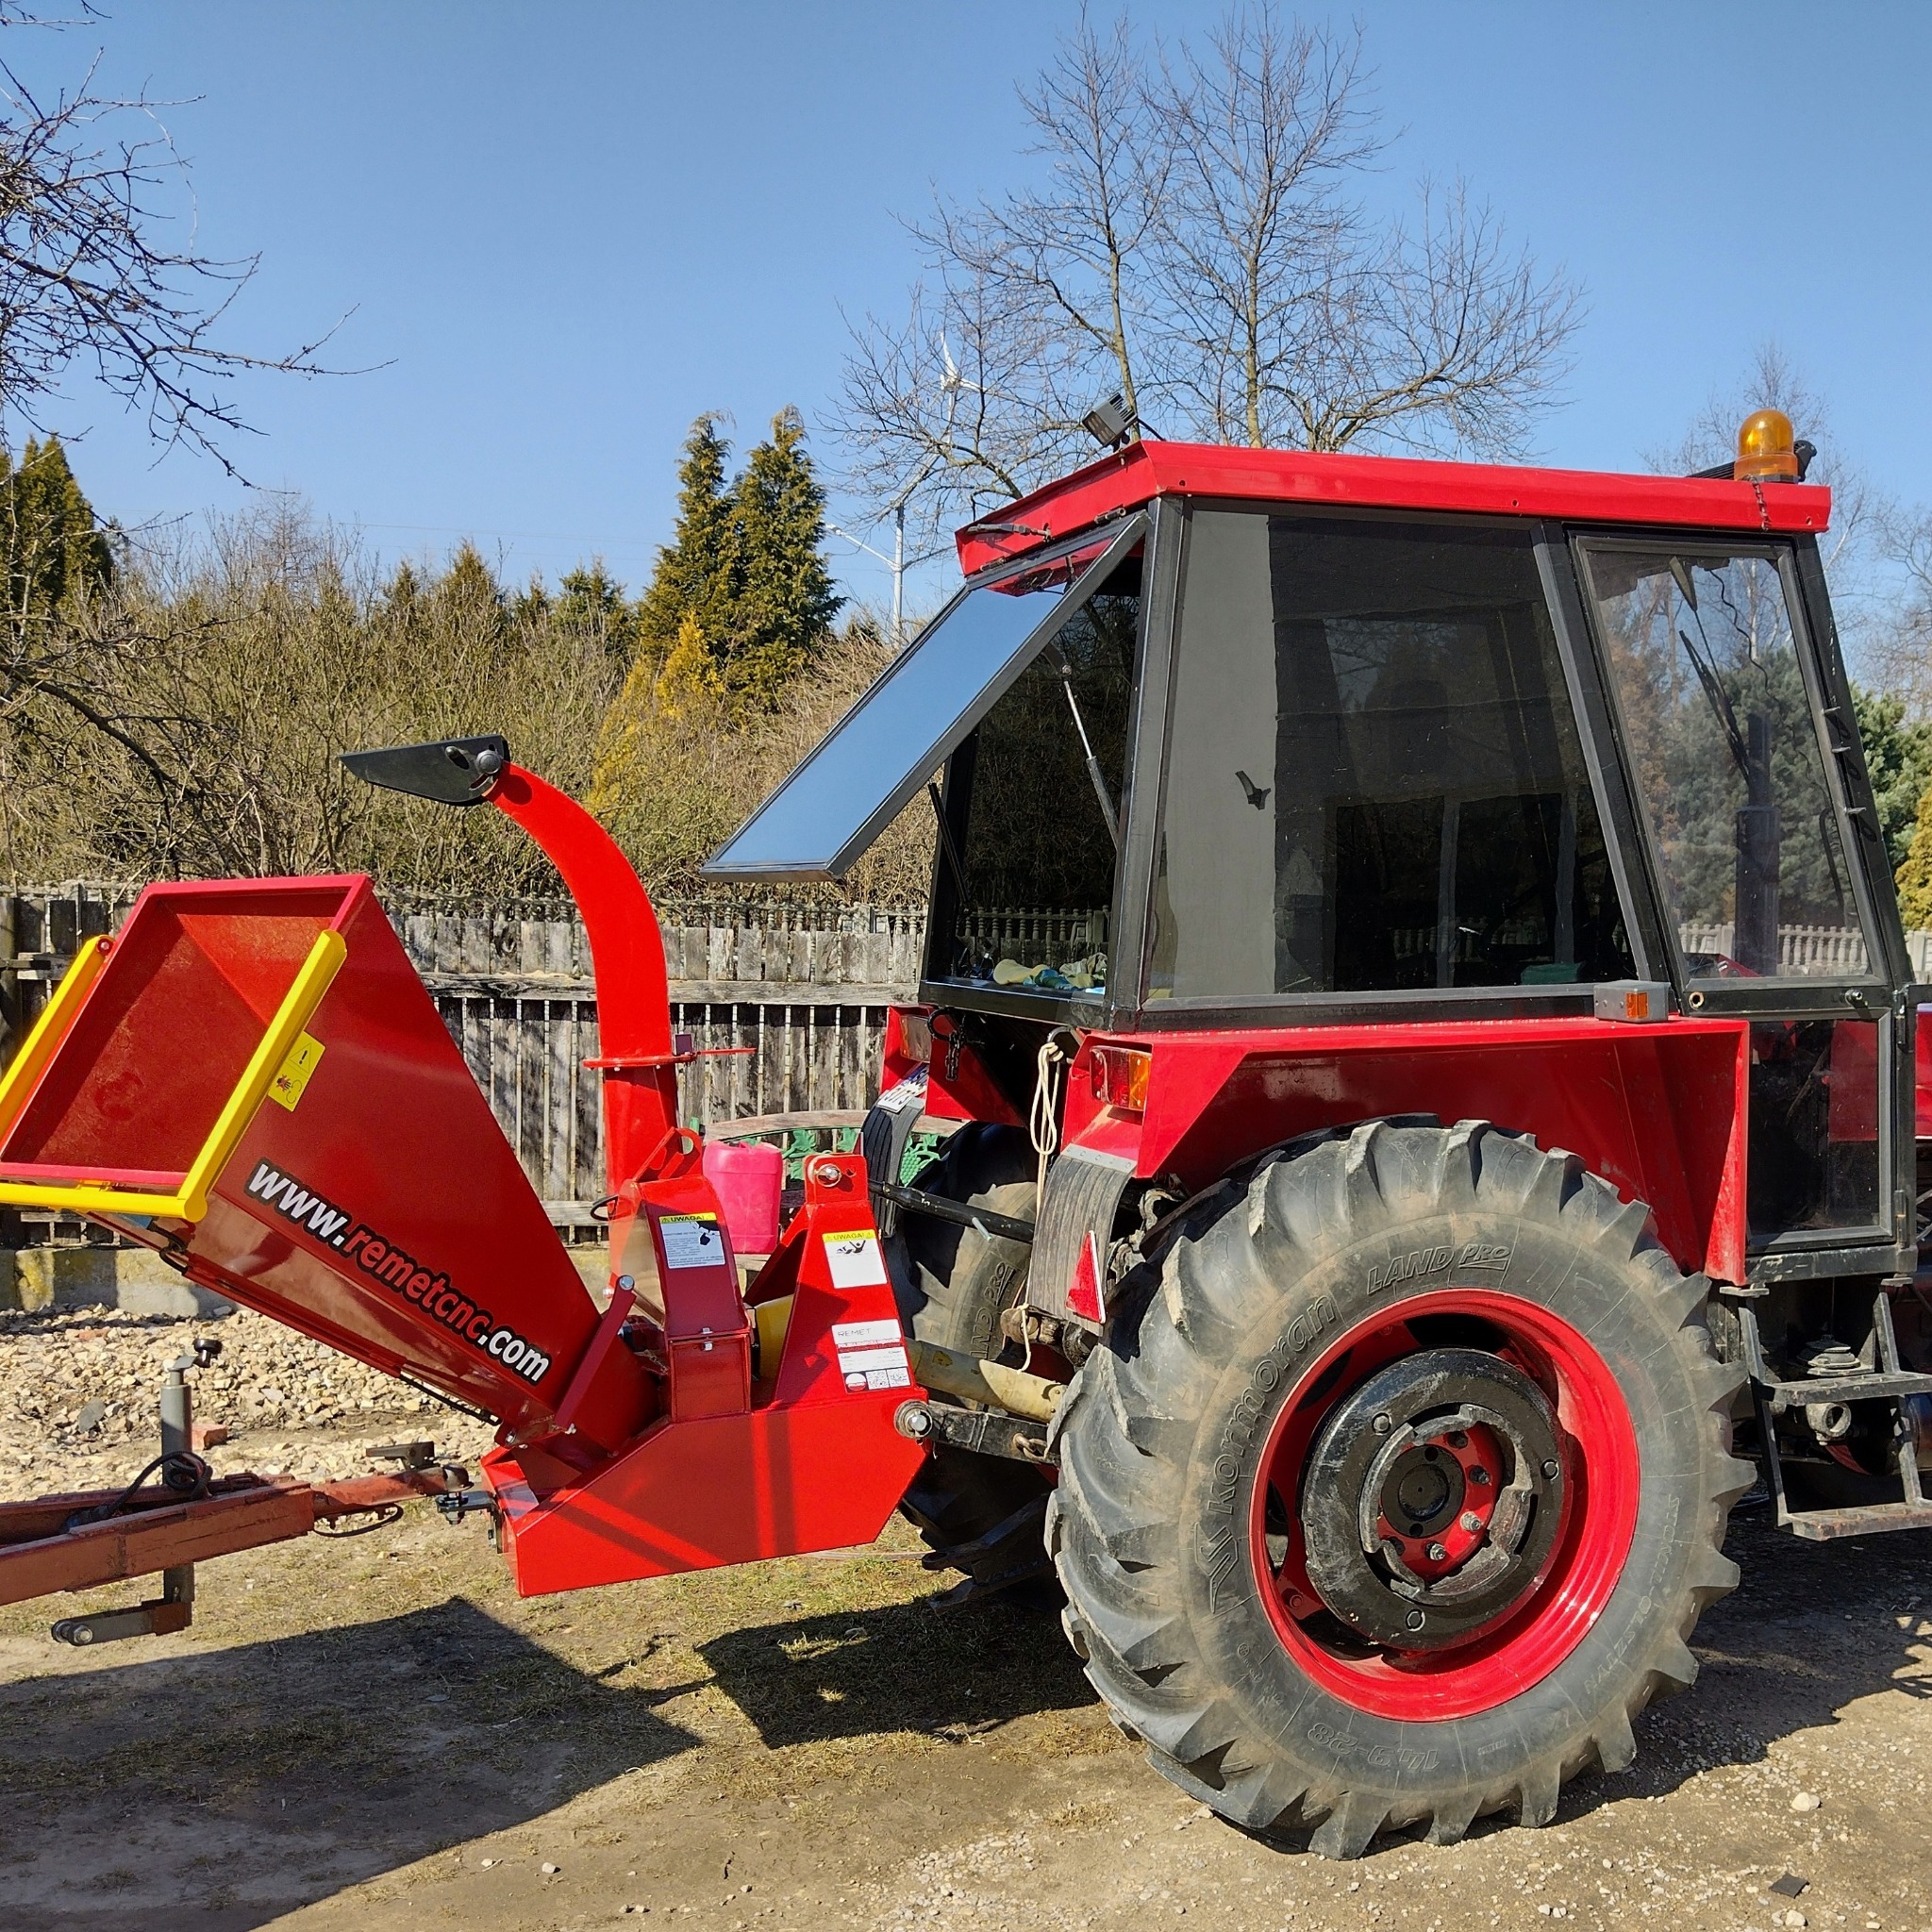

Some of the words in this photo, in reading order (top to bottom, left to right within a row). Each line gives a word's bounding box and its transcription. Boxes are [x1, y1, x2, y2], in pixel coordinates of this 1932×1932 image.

[248, 1162, 551, 1383] www.remetcnc.com
[983, 1261, 1006, 1307] PRO
[1367, 1245, 1455, 1296] LAND
[1458, 1243, 1510, 1265] PRO
[1207, 1293, 1337, 1516] kormoran
